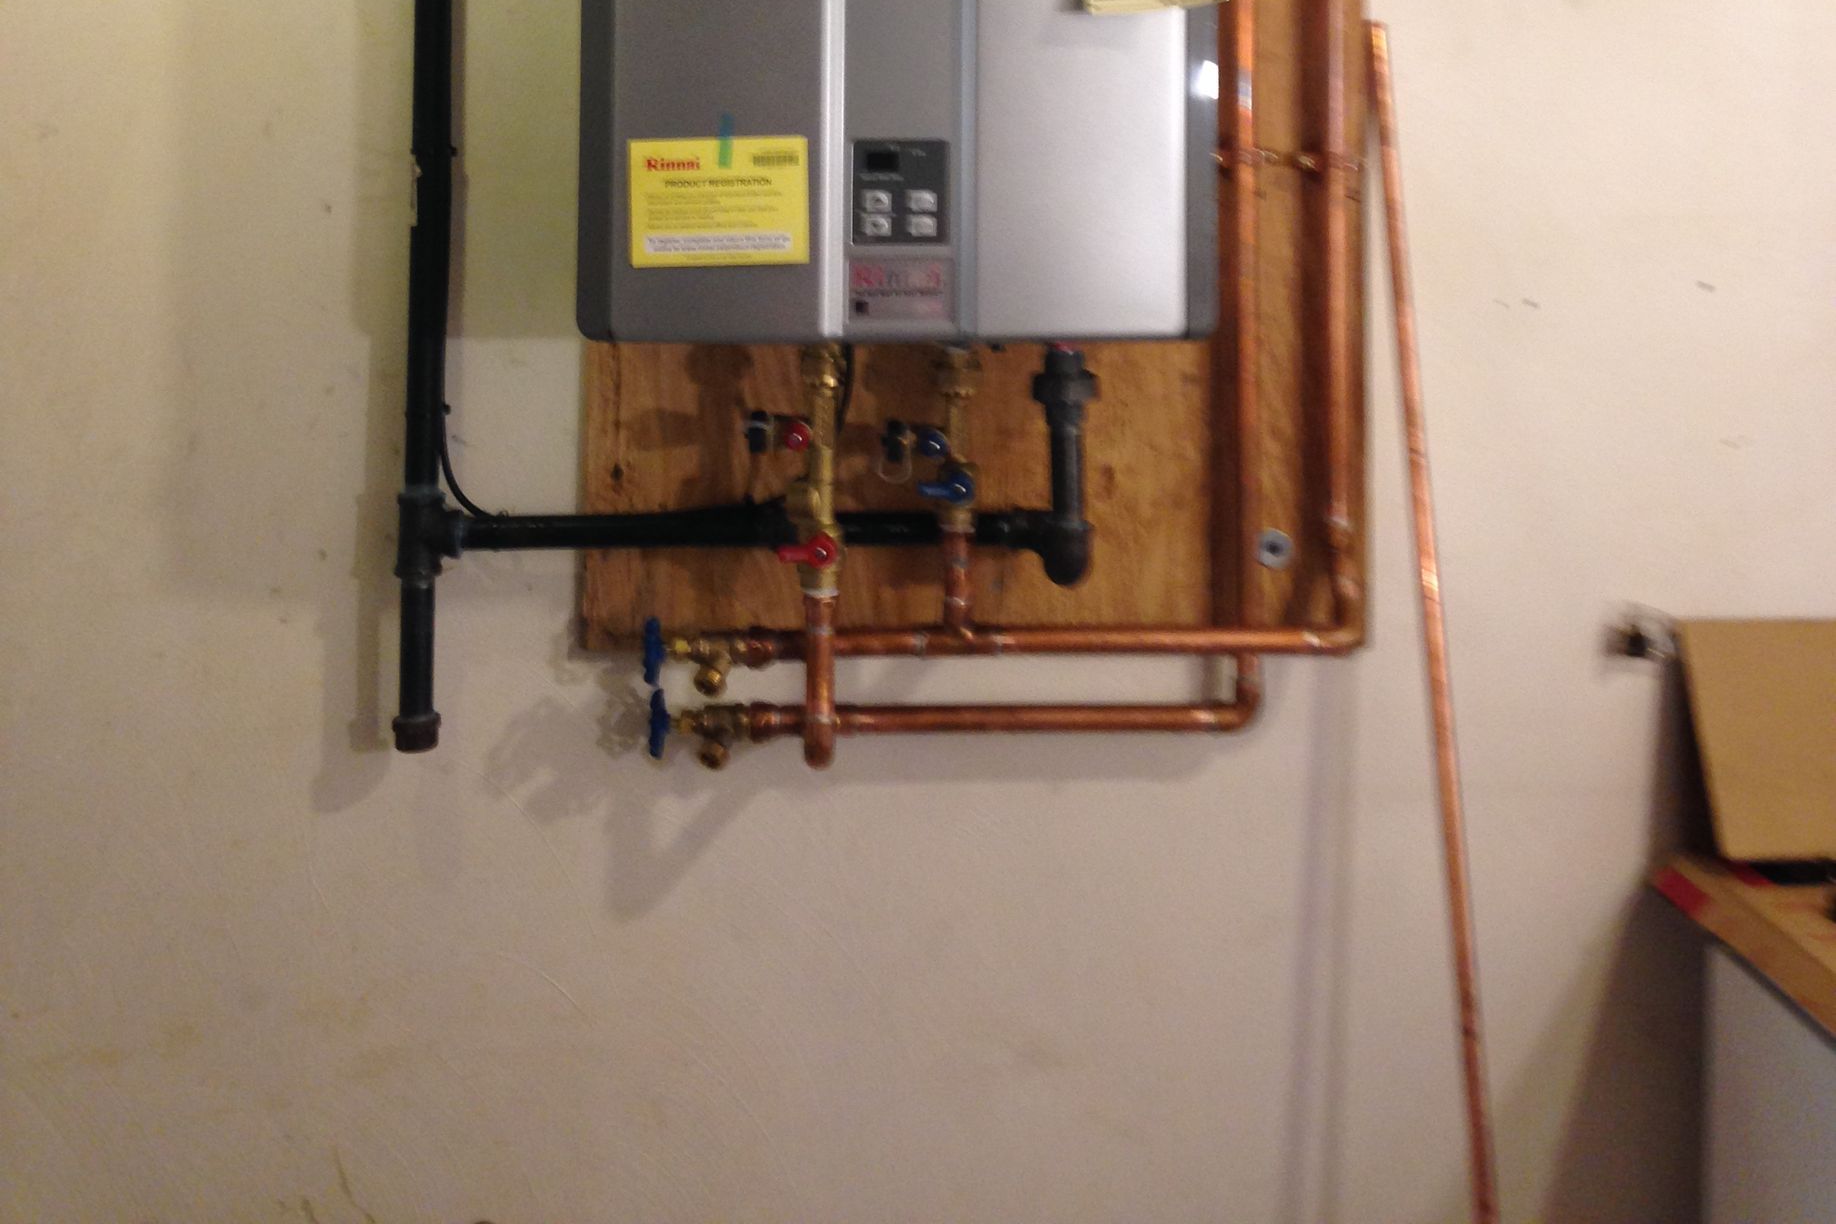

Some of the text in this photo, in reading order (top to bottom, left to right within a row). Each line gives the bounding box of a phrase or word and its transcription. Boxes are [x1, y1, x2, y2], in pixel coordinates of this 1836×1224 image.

[646, 156, 701, 172] Rinnai
[665, 176, 773, 189] PRODUCT REGISTRATION
